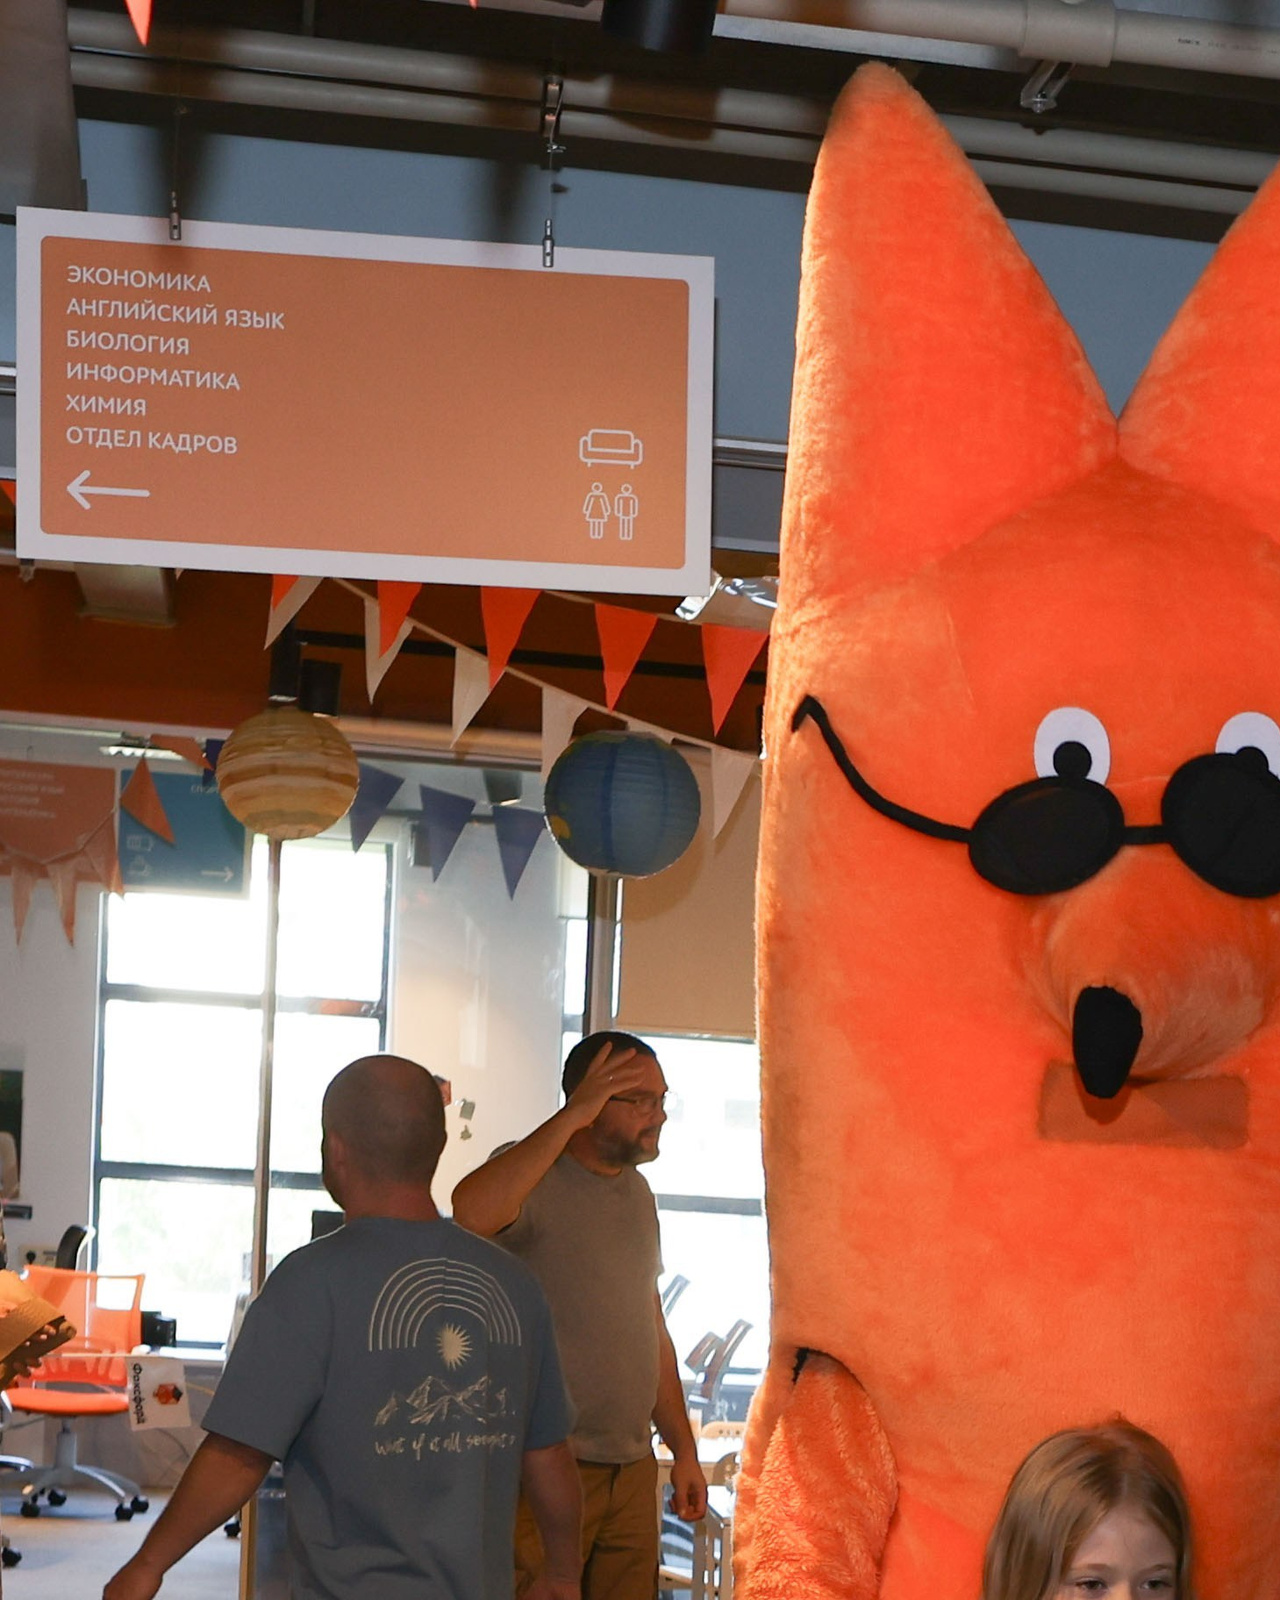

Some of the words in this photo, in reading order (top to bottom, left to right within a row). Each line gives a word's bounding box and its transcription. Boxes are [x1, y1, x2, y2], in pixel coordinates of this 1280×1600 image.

[67, 265, 212, 293] ЭКОНОМИКА
[66, 298, 218, 325] АНГЛИЙСКИЙ
[224, 309, 285, 330] ЯЗЫК
[66, 330, 190, 355] БИОЛОГИЯ
[66, 362, 241, 390] ИНФОРМАТИКА
[66, 394, 147, 416] ХИМИЯ
[66, 426, 142, 449] ОТДЕЛ
[149, 432, 238, 455] КАДРОВ
